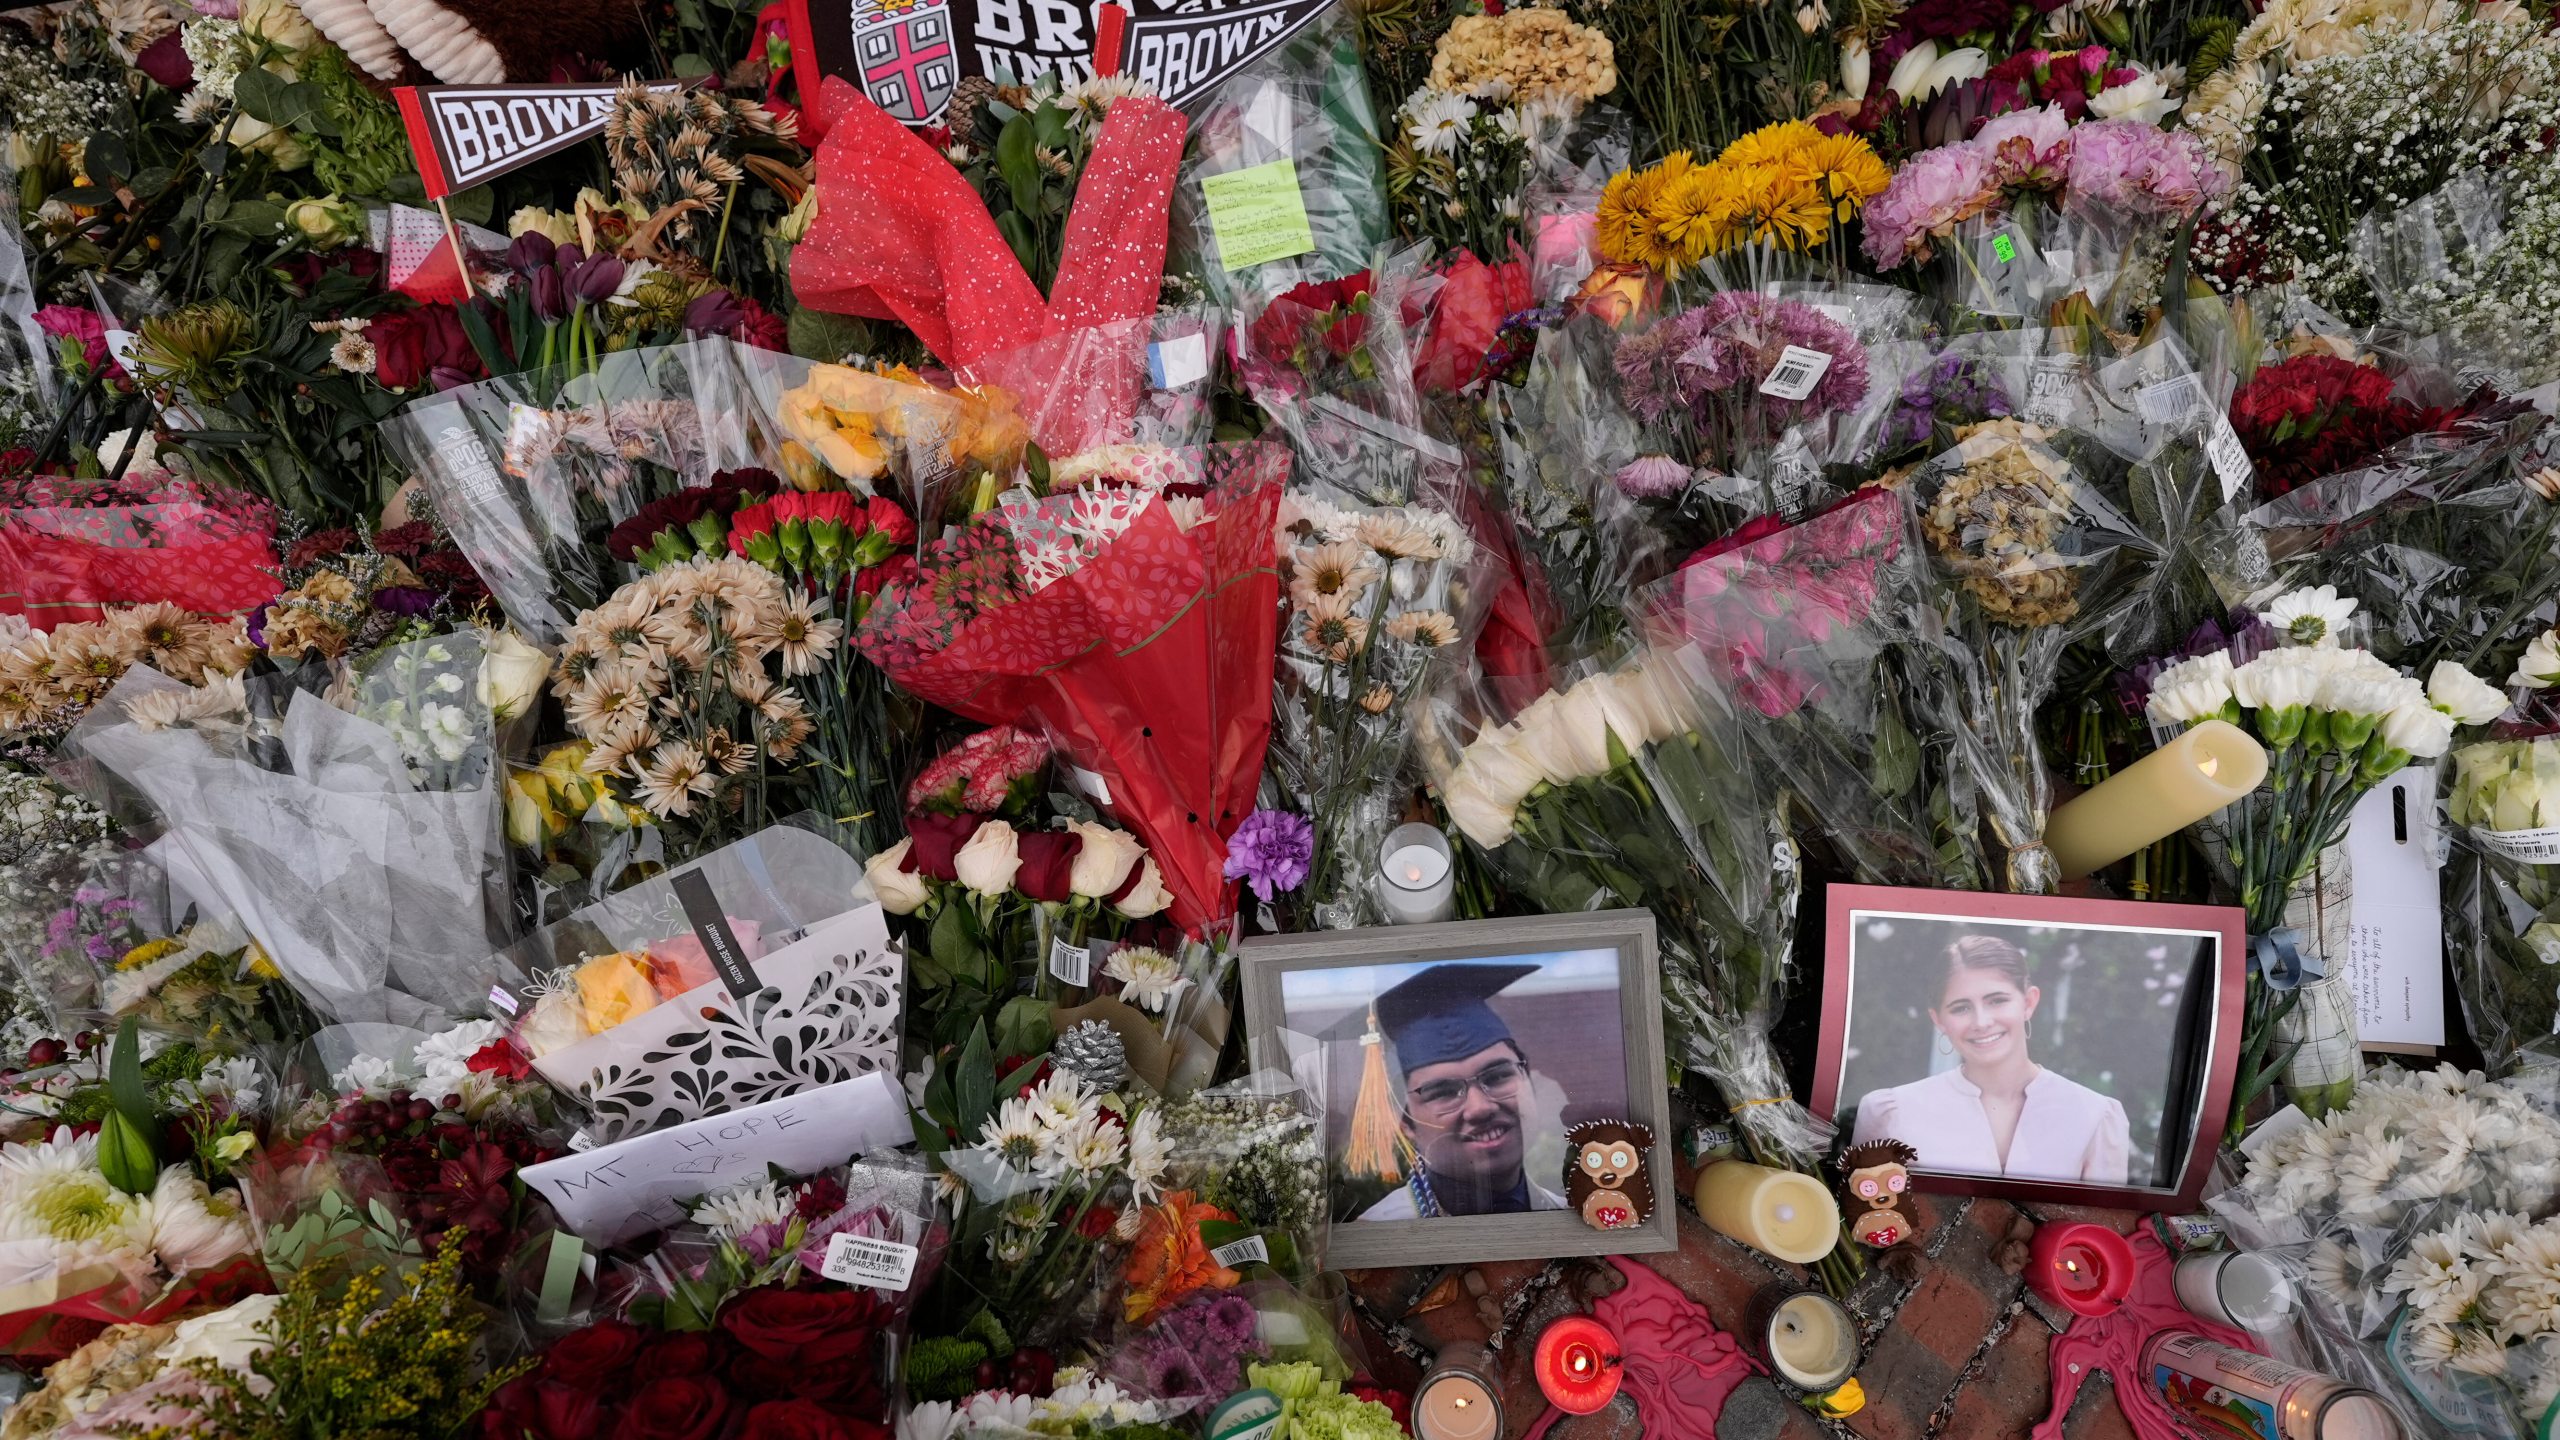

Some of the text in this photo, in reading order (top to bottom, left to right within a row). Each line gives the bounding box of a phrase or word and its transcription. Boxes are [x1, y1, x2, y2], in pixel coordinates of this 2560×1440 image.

[1138, 10, 1288, 98] BROWN
[440, 96, 608, 172] BROWN
[2032, 372, 2076, 398] 90%
[705, 923, 745, 984] DOZEN ROSE BOUQUET
[673, 1107, 807, 1152] HOPE
[554, 1155, 627, 1200] MT
[845, 1238, 909, 1254] HAPPINESS BOUQUET
[831, 1264, 846, 1274] 335
